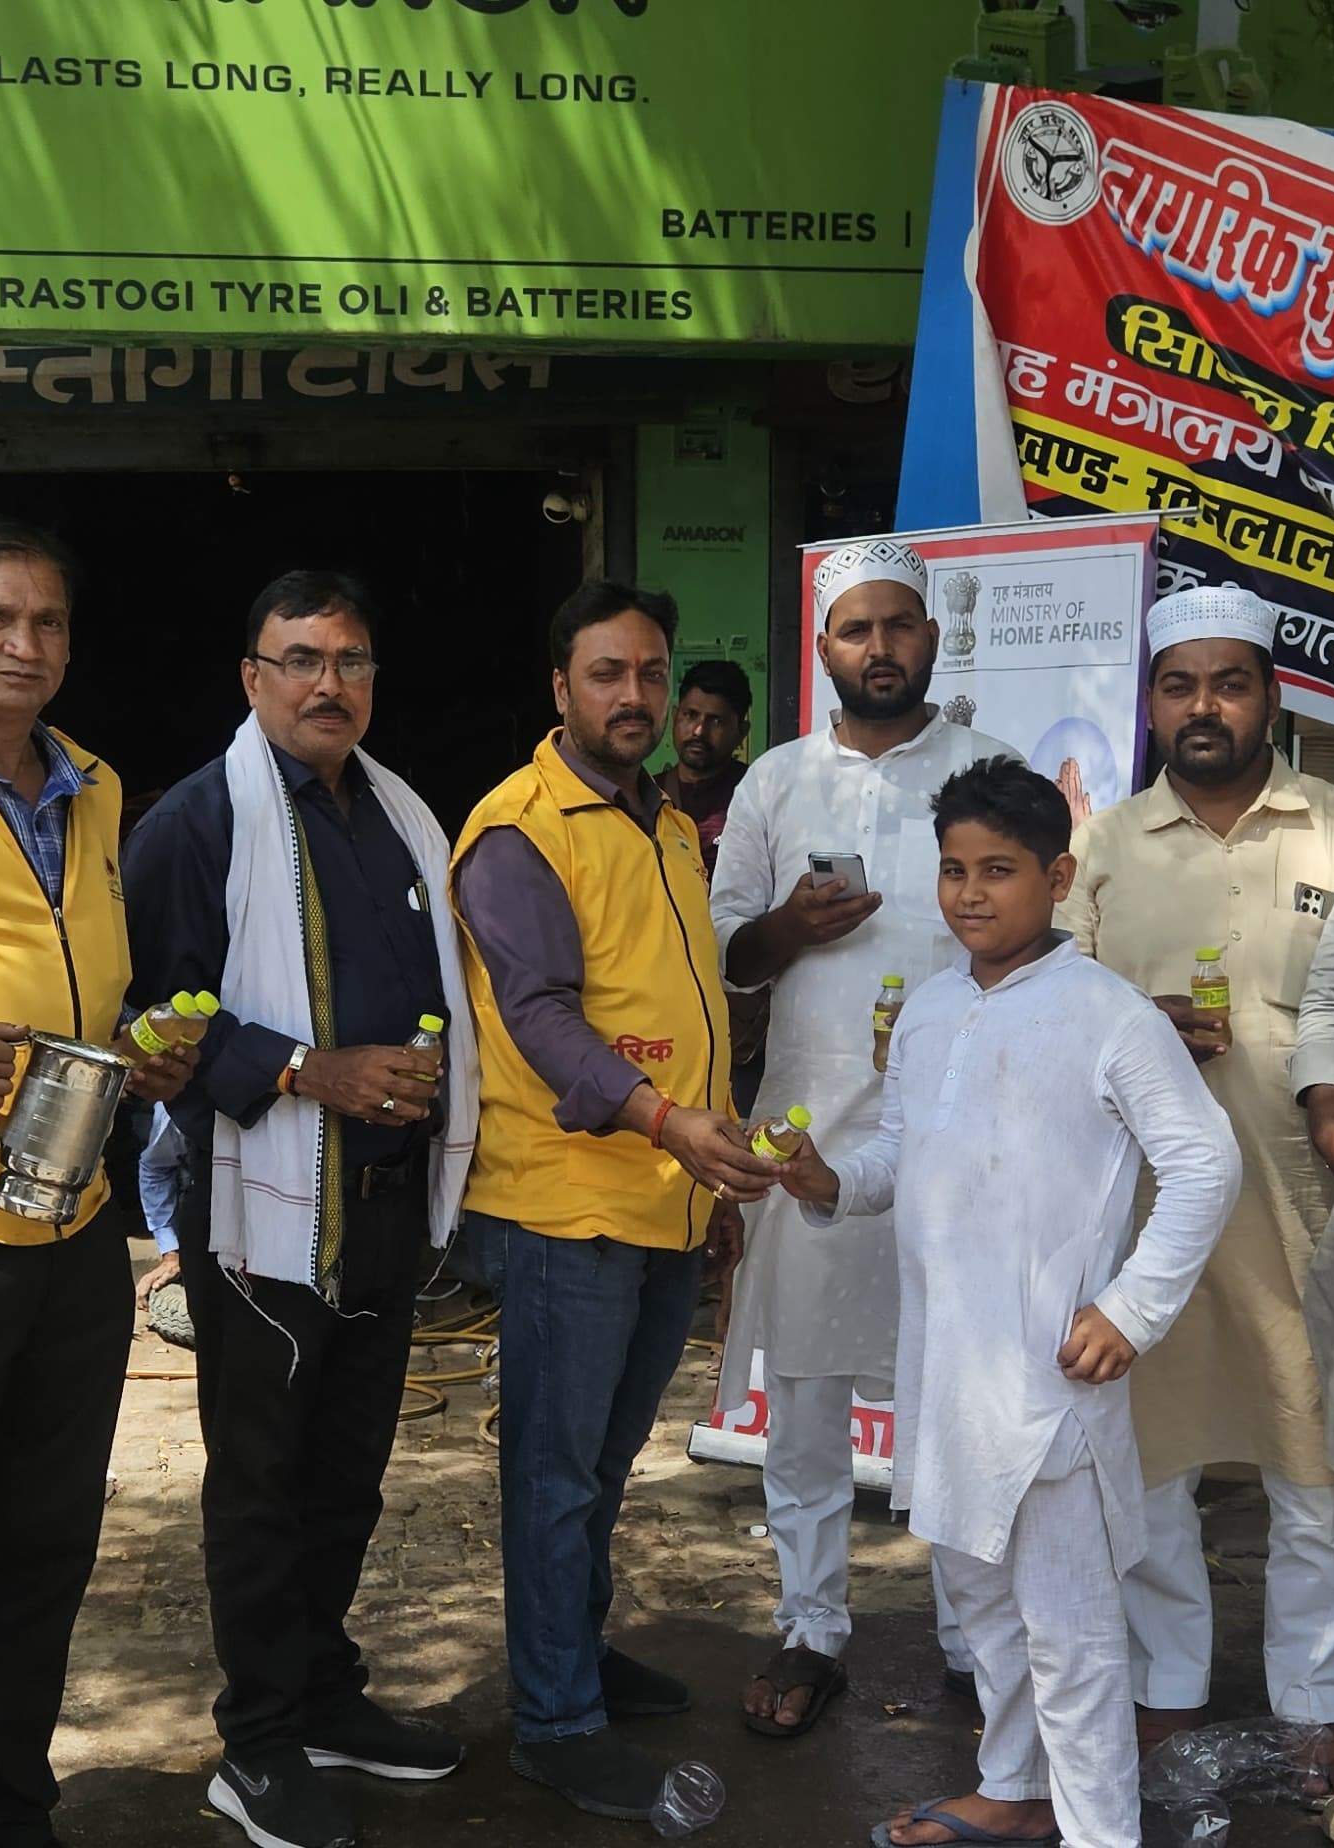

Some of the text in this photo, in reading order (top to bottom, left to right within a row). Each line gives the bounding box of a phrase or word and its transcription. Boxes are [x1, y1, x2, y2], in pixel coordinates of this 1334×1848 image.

[165, 60, 307, 98] LONG,
[325, 66, 494, 100] REALLY
[514, 71, 650, 104] LONG.
[661, 208, 877, 242] BATTERIES
[211, 281, 323, 315] TYRE
[338, 284, 408, 316] OLI
[425, 285, 451, 317] &
[467, 286, 694, 321] BATTERIES
[1064, 358, 1284, 478] मंत्रालय
[662, 525, 746, 543] AMARON
[992, 580, 1055, 606] गृह मंत्रालय
[990, 600, 1086, 625] MINISTRY OF
[989, 620, 1124, 648] HOME AFFAIRS
